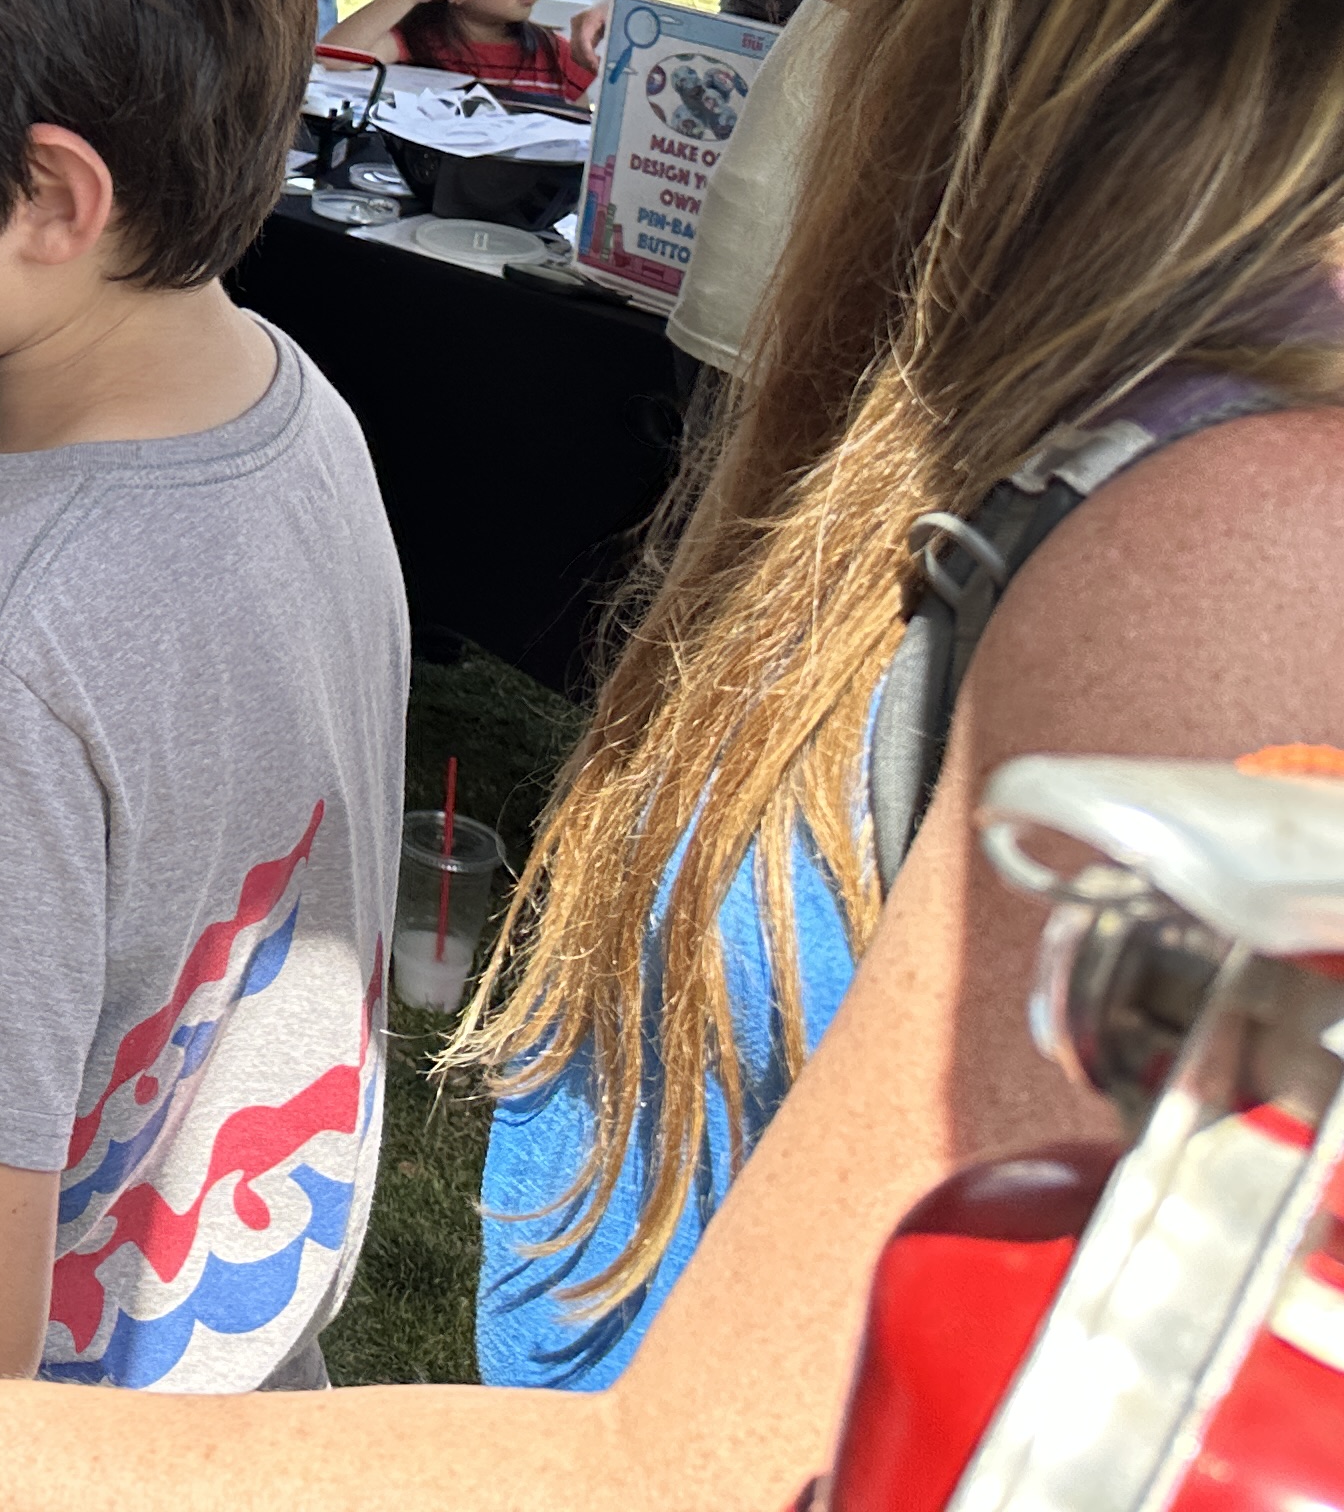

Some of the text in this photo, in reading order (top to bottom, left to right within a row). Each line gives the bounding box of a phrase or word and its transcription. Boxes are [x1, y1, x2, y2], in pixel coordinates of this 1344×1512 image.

[650, 134, 699, 159] MAKE
[630, 153, 691, 182] DESIGN
[659, 189, 702, 214] OWN
[637, 207, 695, 239] PIN-BA
[637, 233, 690, 264] BUTTO
